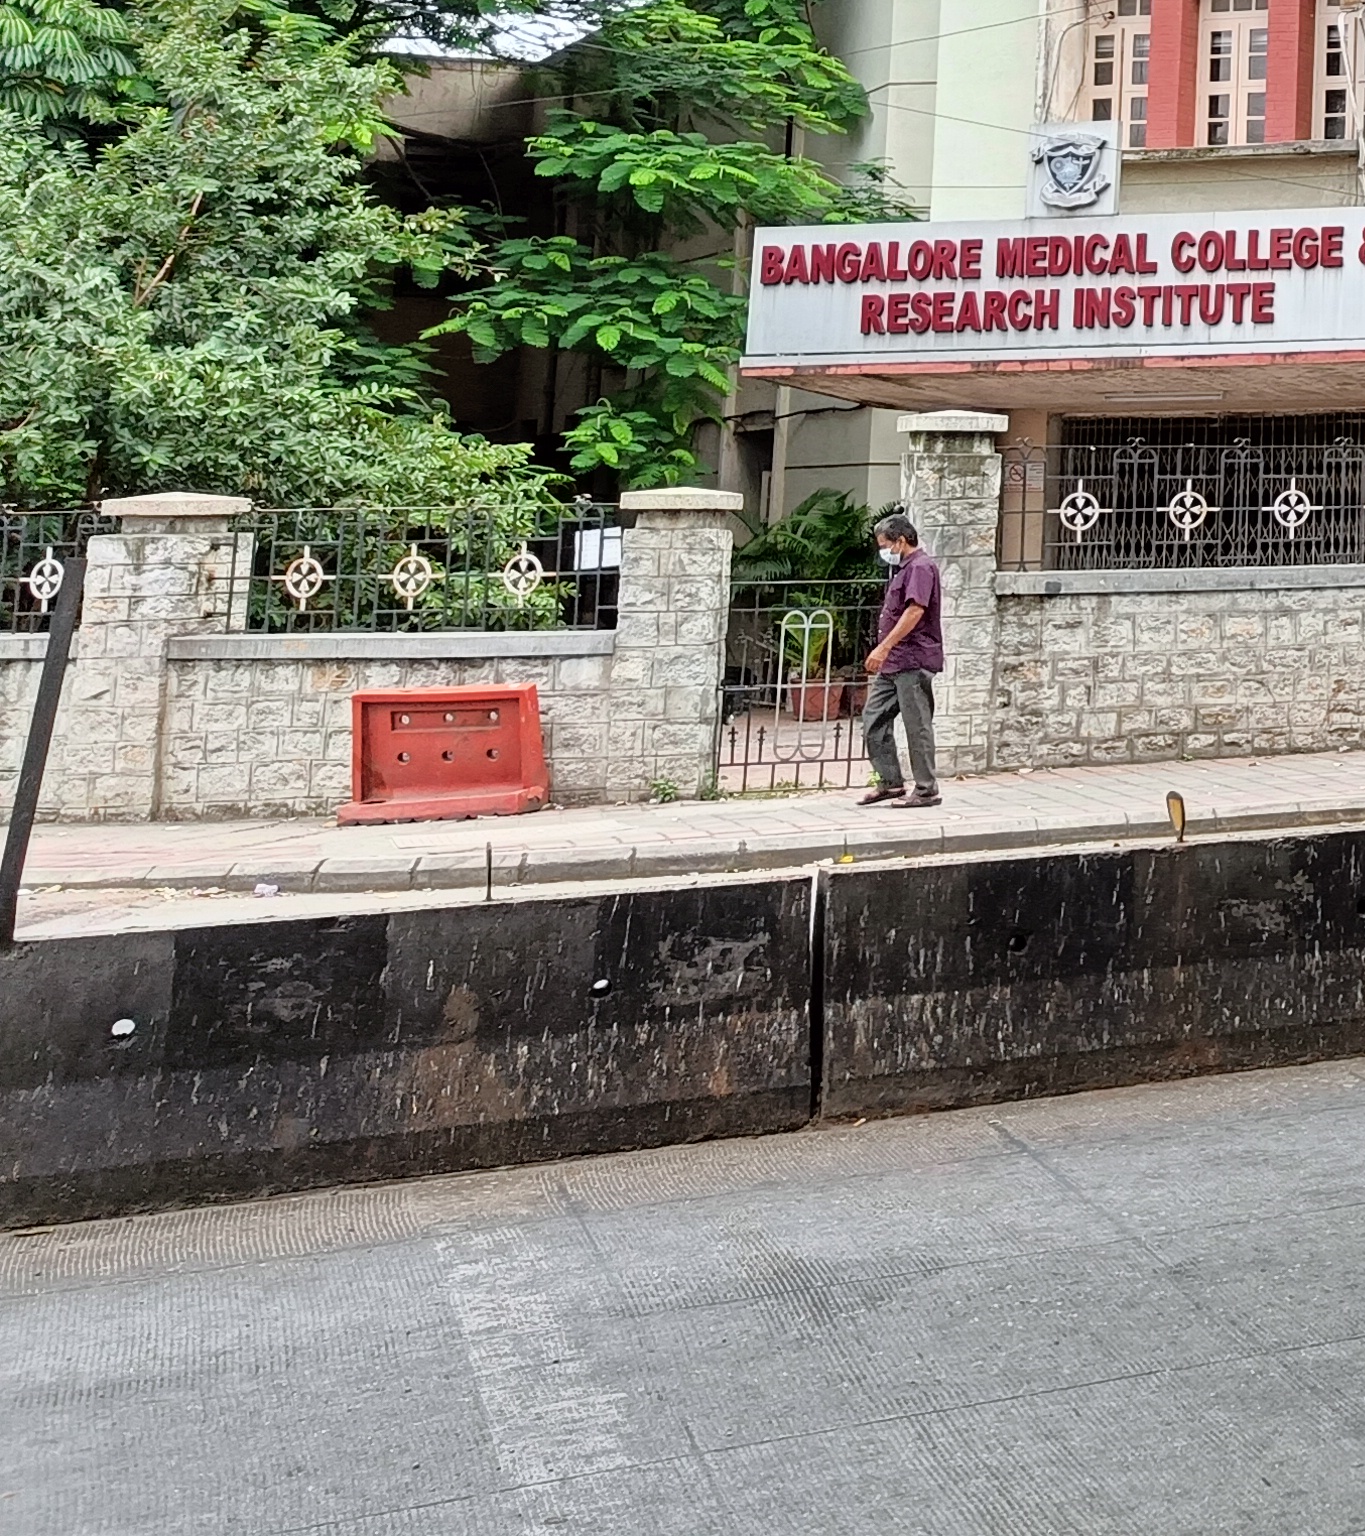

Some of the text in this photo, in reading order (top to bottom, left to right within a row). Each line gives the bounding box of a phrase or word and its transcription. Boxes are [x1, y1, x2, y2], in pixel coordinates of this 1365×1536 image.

[760, 238, 983, 285] BANGALORE
[995, 232, 1158, 278] MEDICAL
[1171, 226, 1344, 273] COLLEGE
[860, 282, 1275, 335] RESEARCH INSTITUTE
